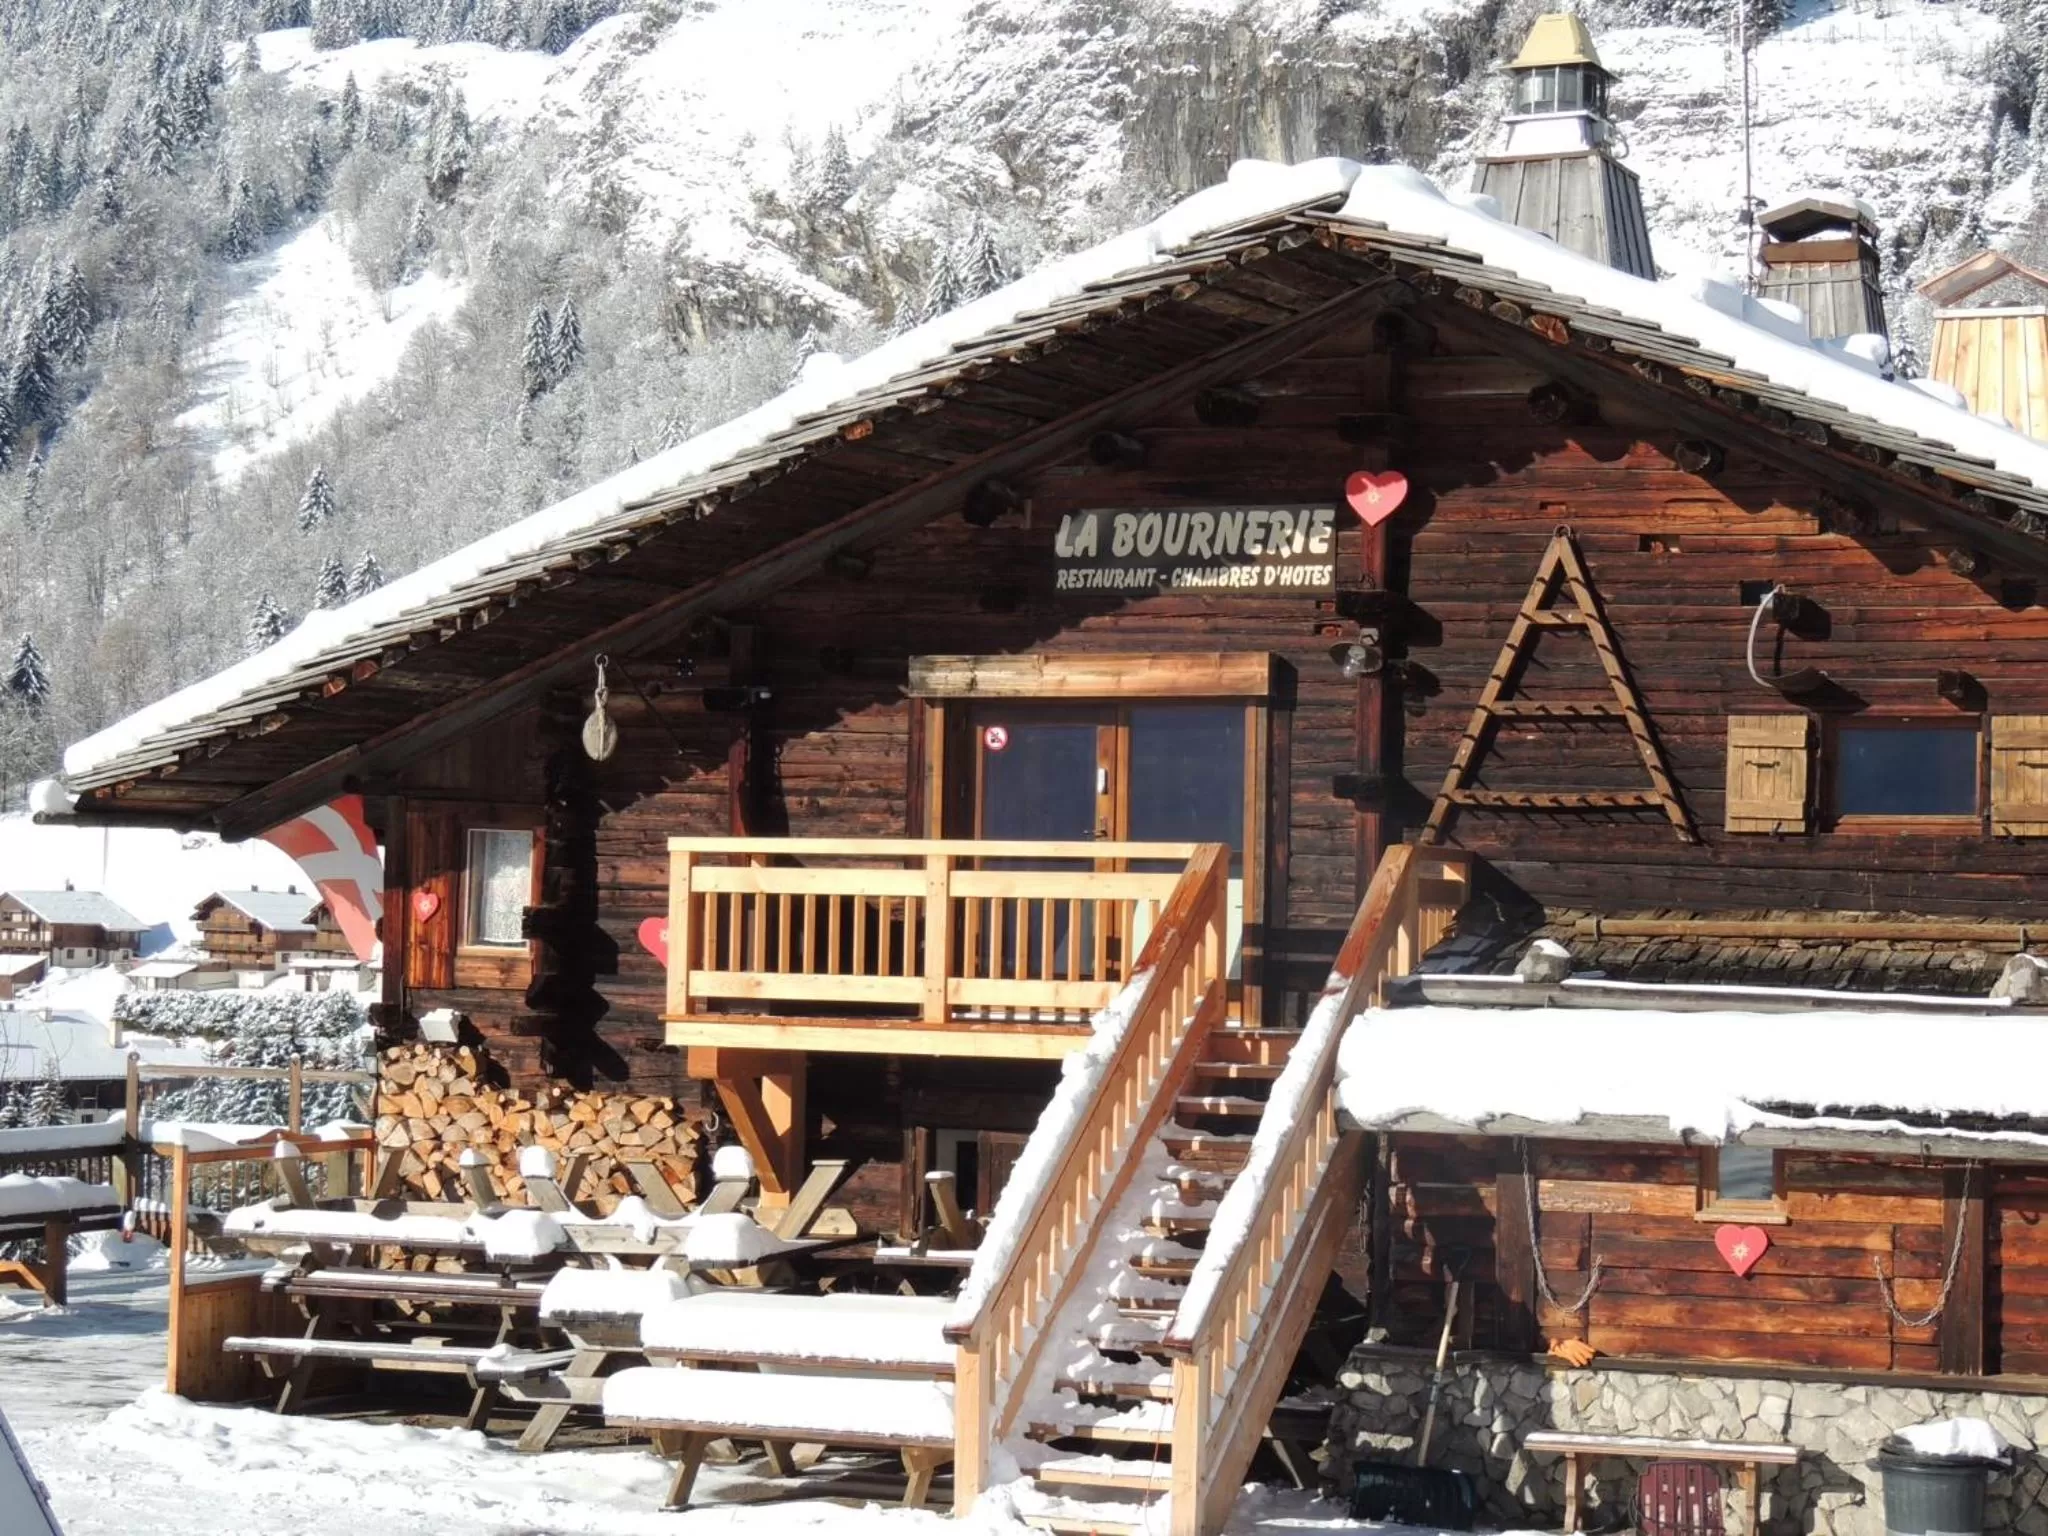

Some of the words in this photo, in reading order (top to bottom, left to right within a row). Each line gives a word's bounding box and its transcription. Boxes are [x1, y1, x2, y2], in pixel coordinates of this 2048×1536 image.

[1055, 513, 1098, 558] LA
[1112, 509, 1336, 559] BOURNERIE
[1056, 567, 1157, 589] RESTAURANT
[1171, 566, 1260, 587] CHAMBRES
[1264, 564, 1333, 586] D'HOTES
